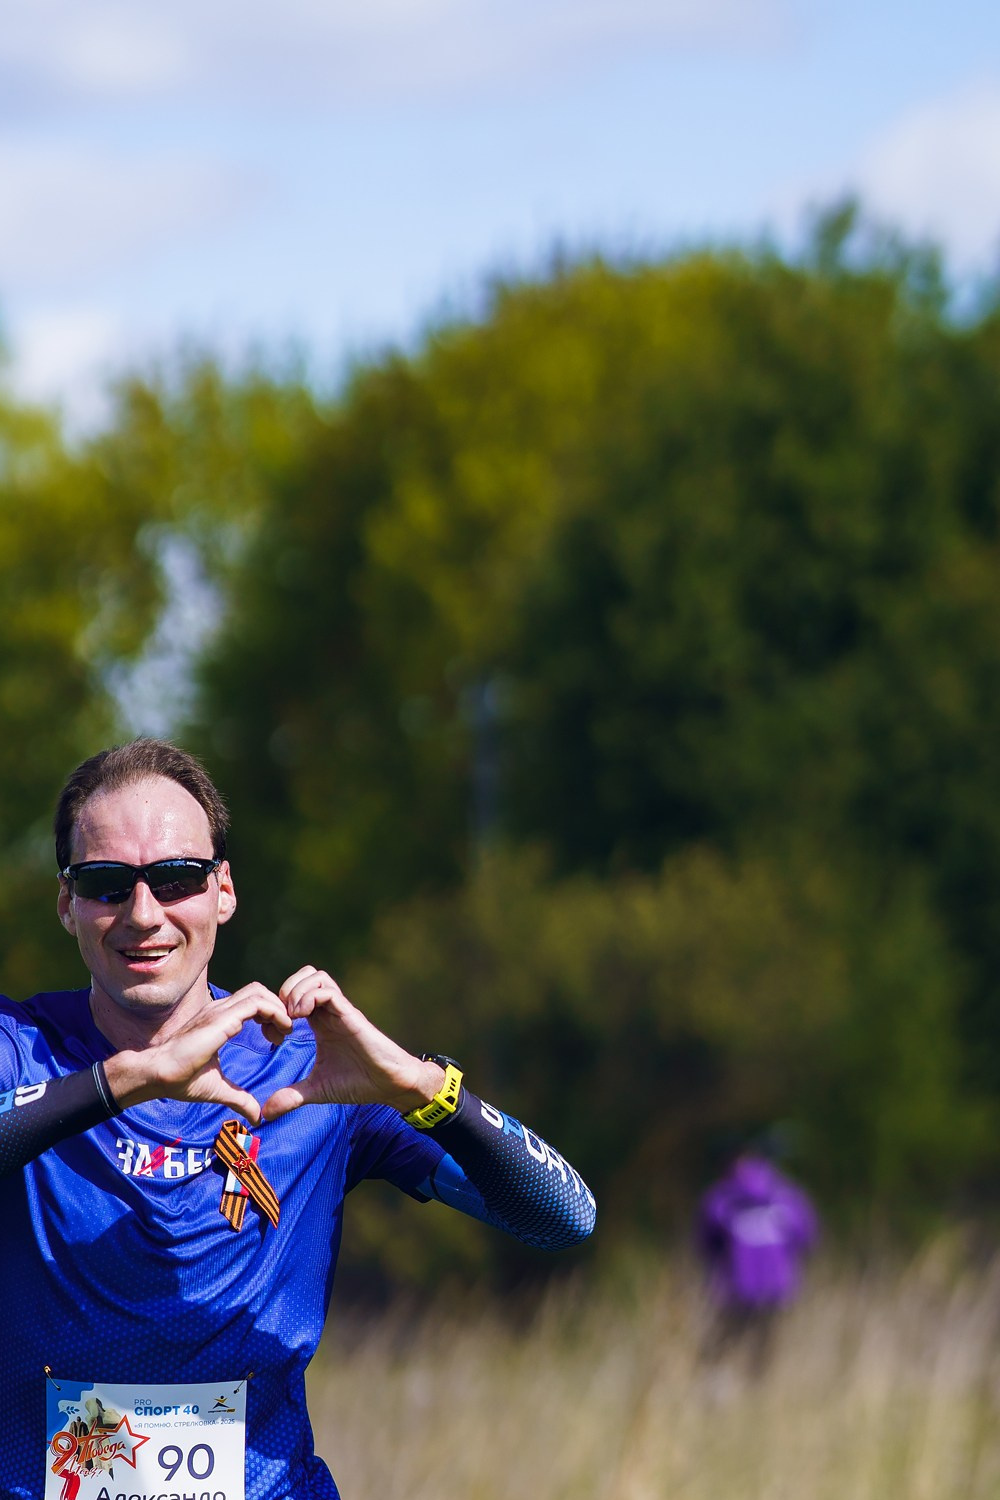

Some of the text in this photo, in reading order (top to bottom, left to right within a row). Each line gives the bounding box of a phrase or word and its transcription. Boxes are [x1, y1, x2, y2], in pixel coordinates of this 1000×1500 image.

[134, 1398, 152, 1406] PRO
[134, 1405, 180, 1416] СПОРТ
[183, 1404, 200, 1415] 40
[157, 1443, 215, 1482] 90
